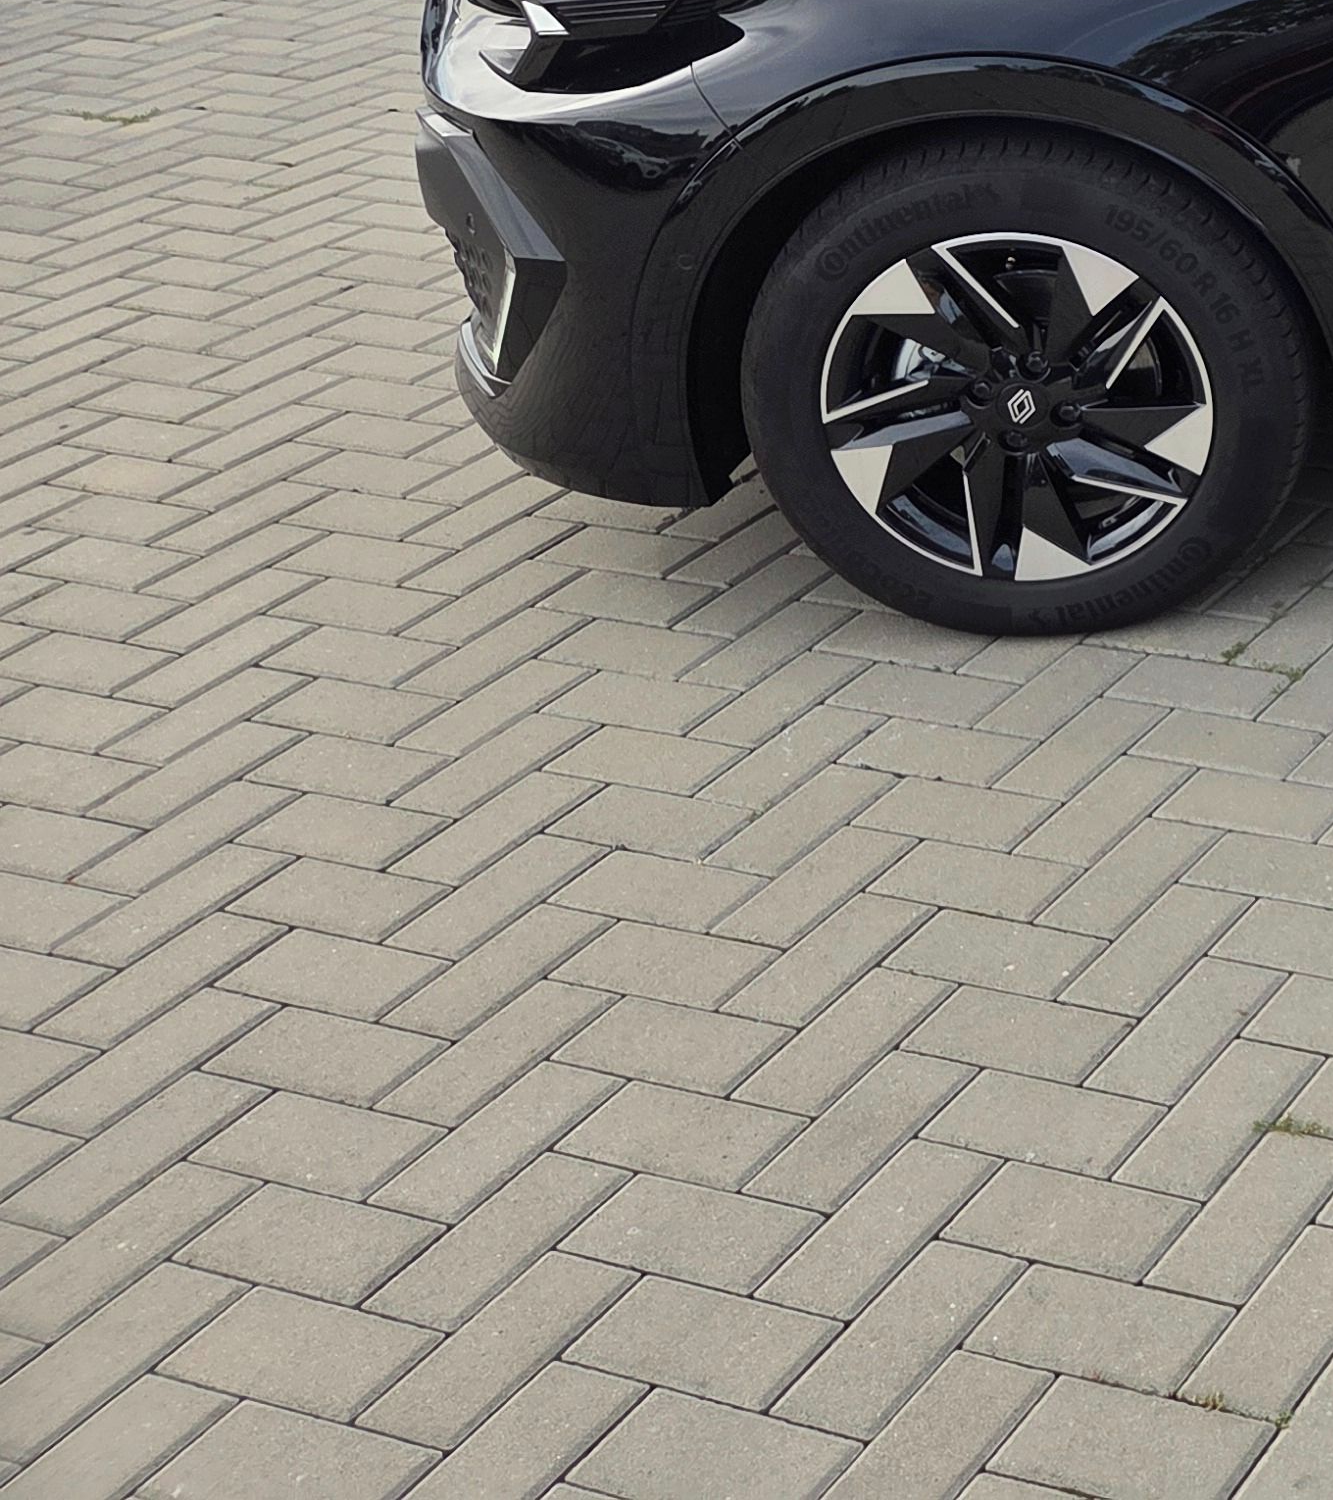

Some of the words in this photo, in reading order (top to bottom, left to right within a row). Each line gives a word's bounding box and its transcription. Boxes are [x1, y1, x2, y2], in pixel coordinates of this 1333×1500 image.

[1104, 203, 1199, 275] 195/60
[1192, 271, 1218, 297] R
[1209, 291, 1241, 325] 16
